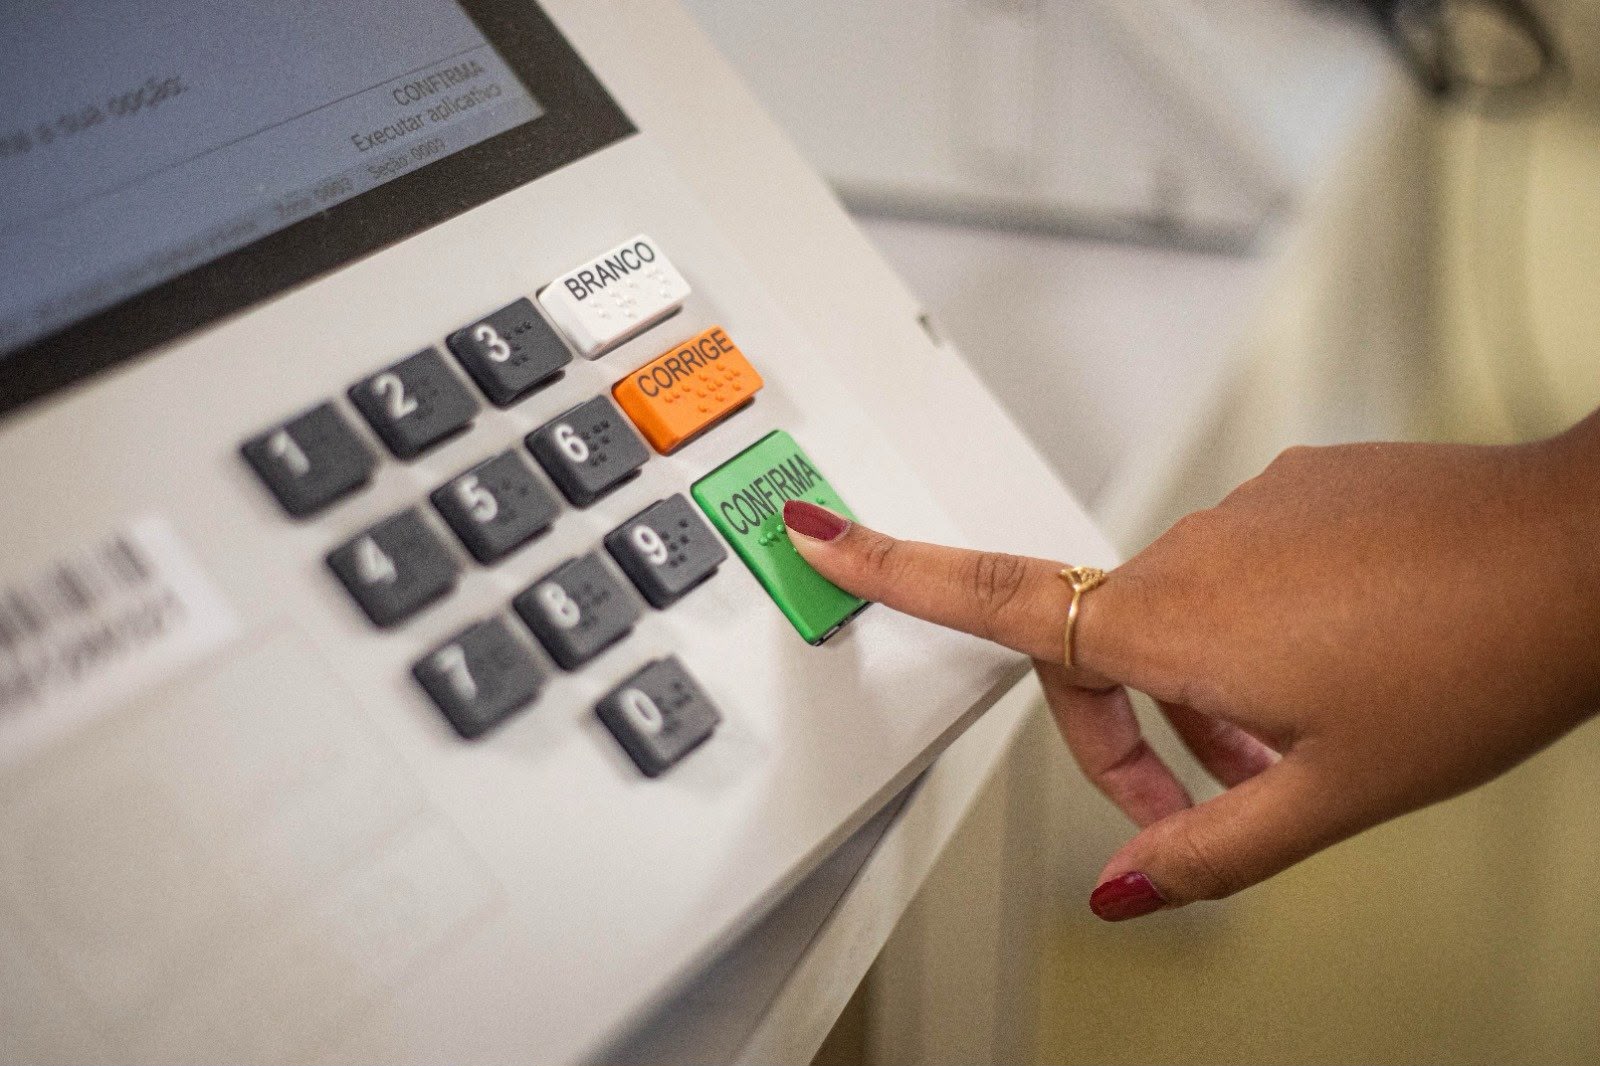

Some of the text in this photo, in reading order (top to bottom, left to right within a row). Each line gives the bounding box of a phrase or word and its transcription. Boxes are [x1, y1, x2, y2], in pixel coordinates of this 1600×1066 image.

[392, 60, 486, 106] CONFIRMA
[350, 84, 503, 153] Executar aplicativo
[564, 240, 656, 302] BRANCO
[474, 324, 511, 363] 3
[636, 327, 735, 399] CORRIGE
[370, 374, 418, 418] 2
[268, 431, 311, 477] 1
[552, 424, 590, 465] 6
[457, 476, 499, 523] 5
[720, 454, 822, 536] CONFIRMA
[356, 537, 398, 583] 4
[632, 524, 670, 566] 9
[540, 583, 581, 629] 8
[436, 646, 477, 699] 7
[621, 688, 663, 736] 0
